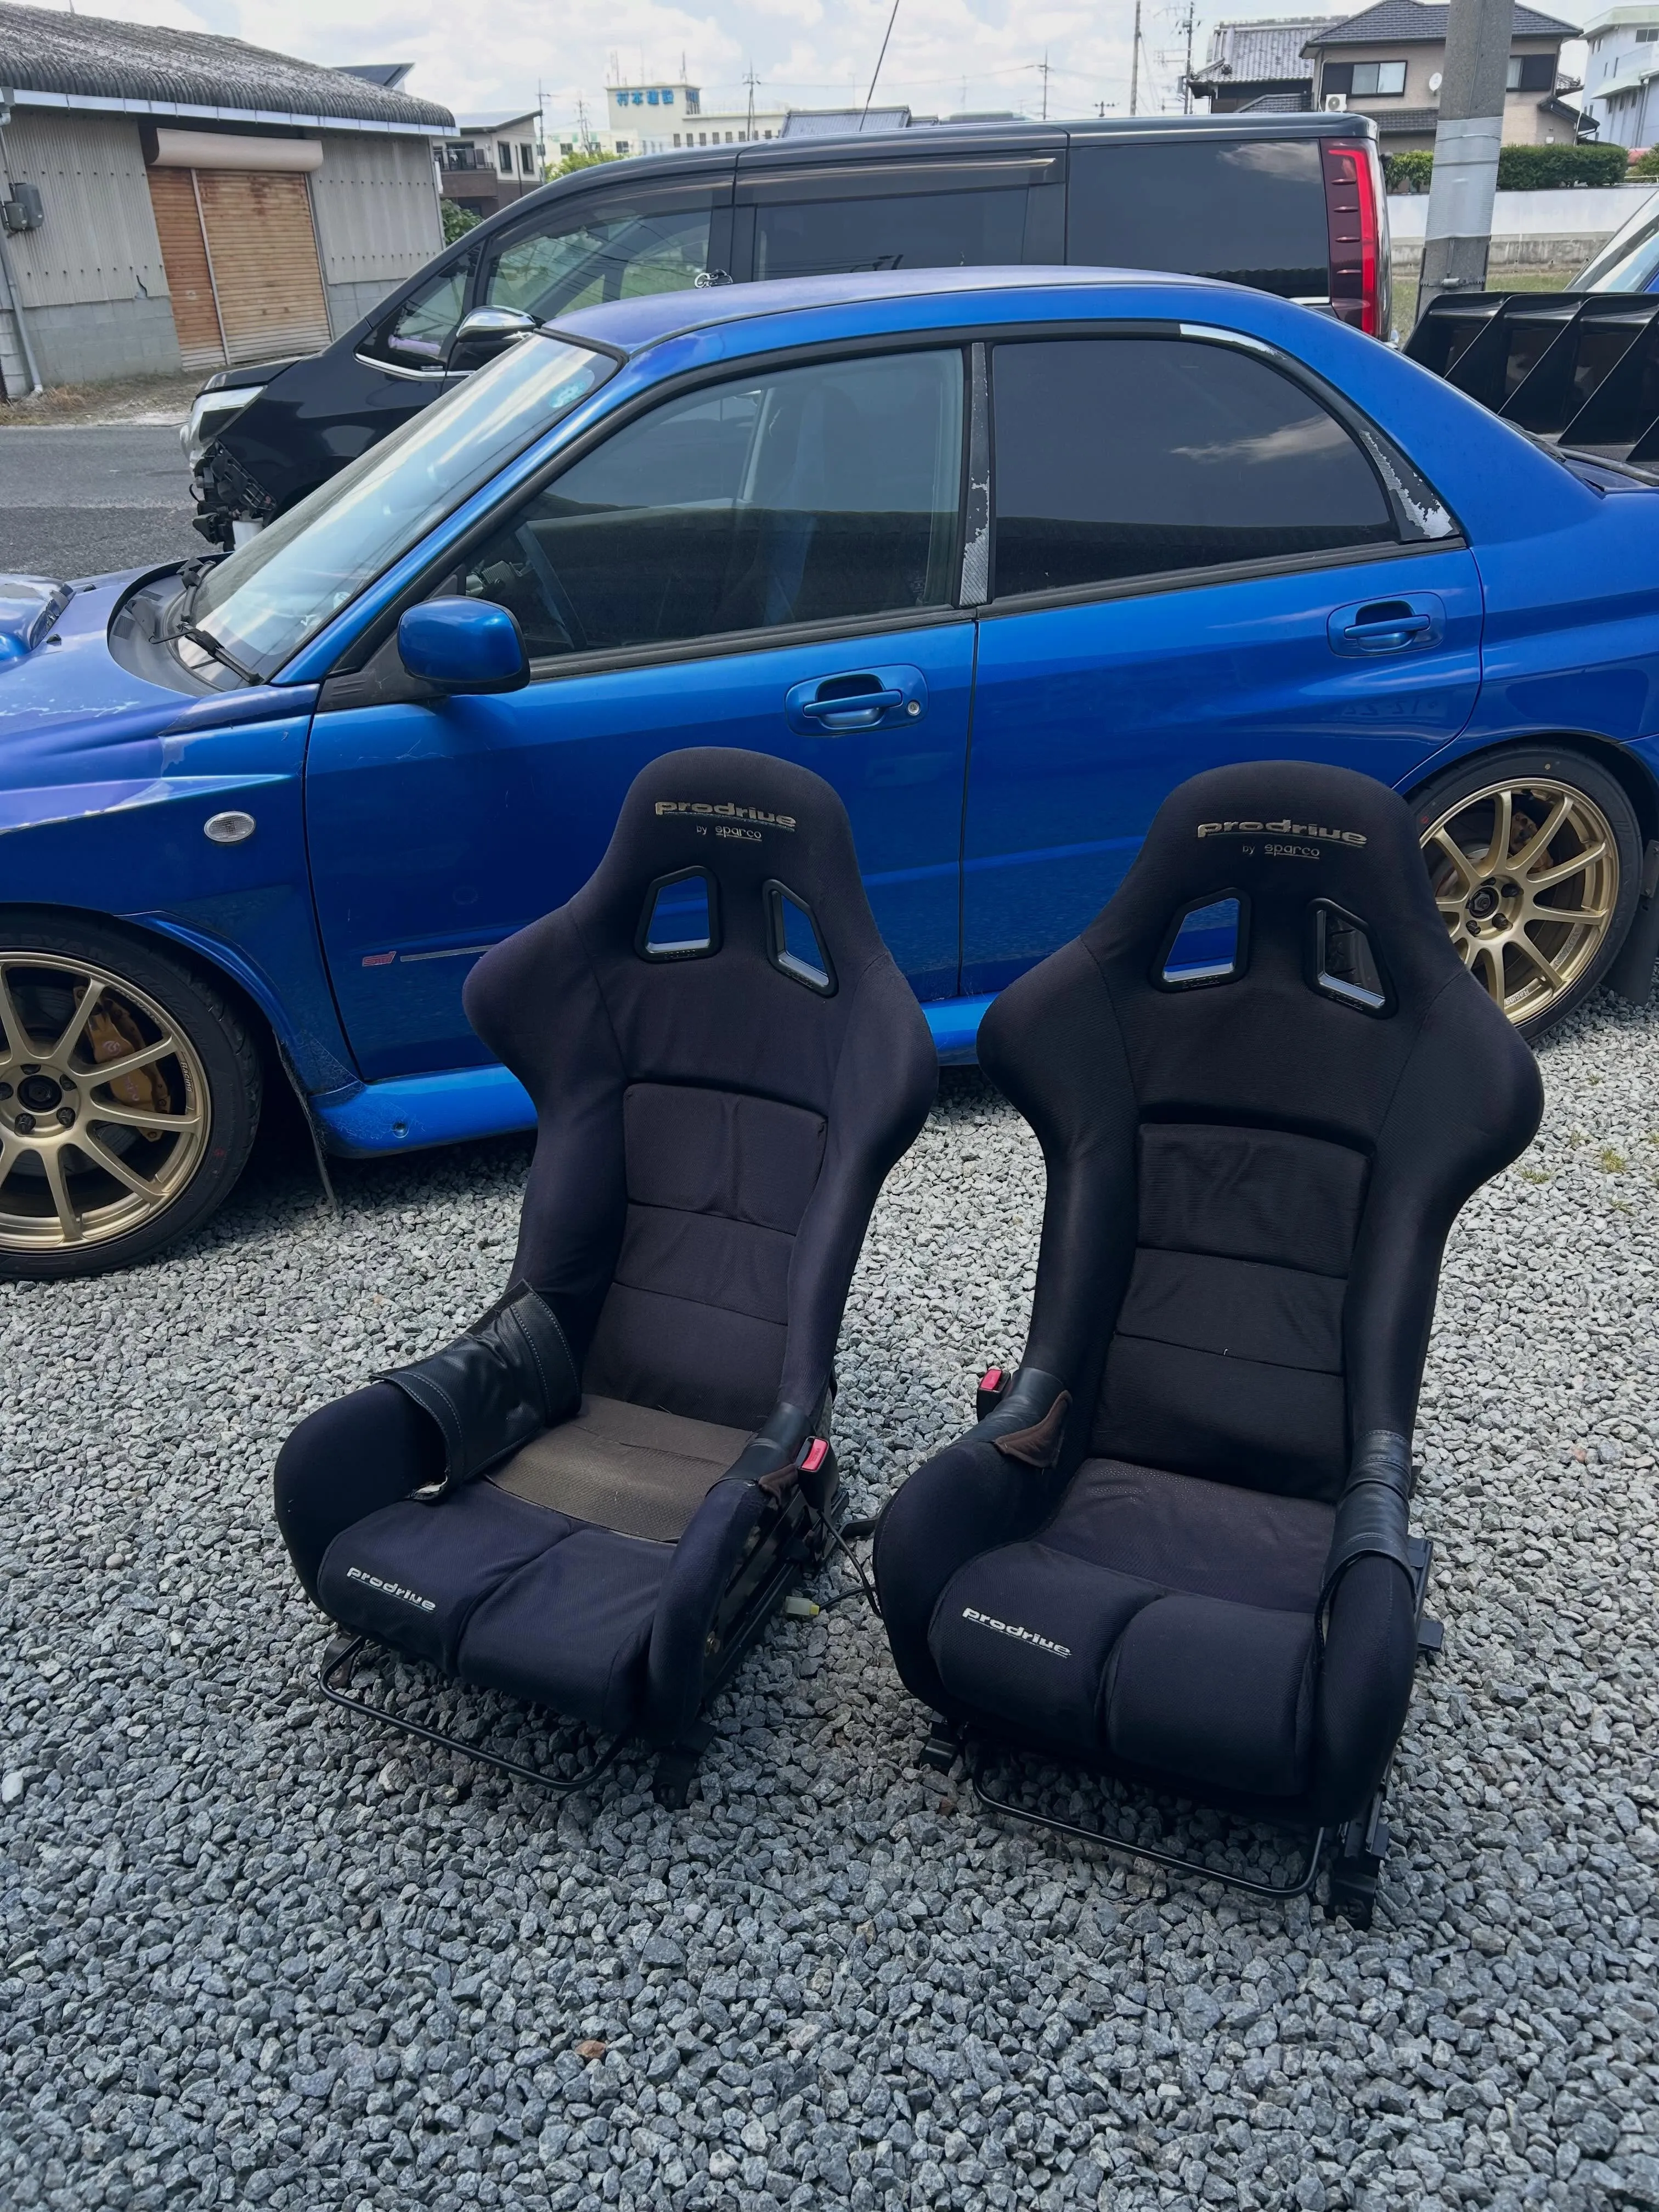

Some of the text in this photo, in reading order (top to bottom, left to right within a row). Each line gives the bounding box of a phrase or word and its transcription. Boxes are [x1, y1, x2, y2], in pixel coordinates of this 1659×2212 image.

[656, 802, 796, 827] prodrive
[696, 825, 707, 835] by
[1198, 820, 1367, 844] prodrive
[1242, 844, 1320, 856] by sparco
[1505, 988, 1530, 1006] Racing
[180, 1062, 193, 1093] Racing
[347, 1567, 436, 1611] prodrive
[962, 1607, 1073, 1656] prodrive
